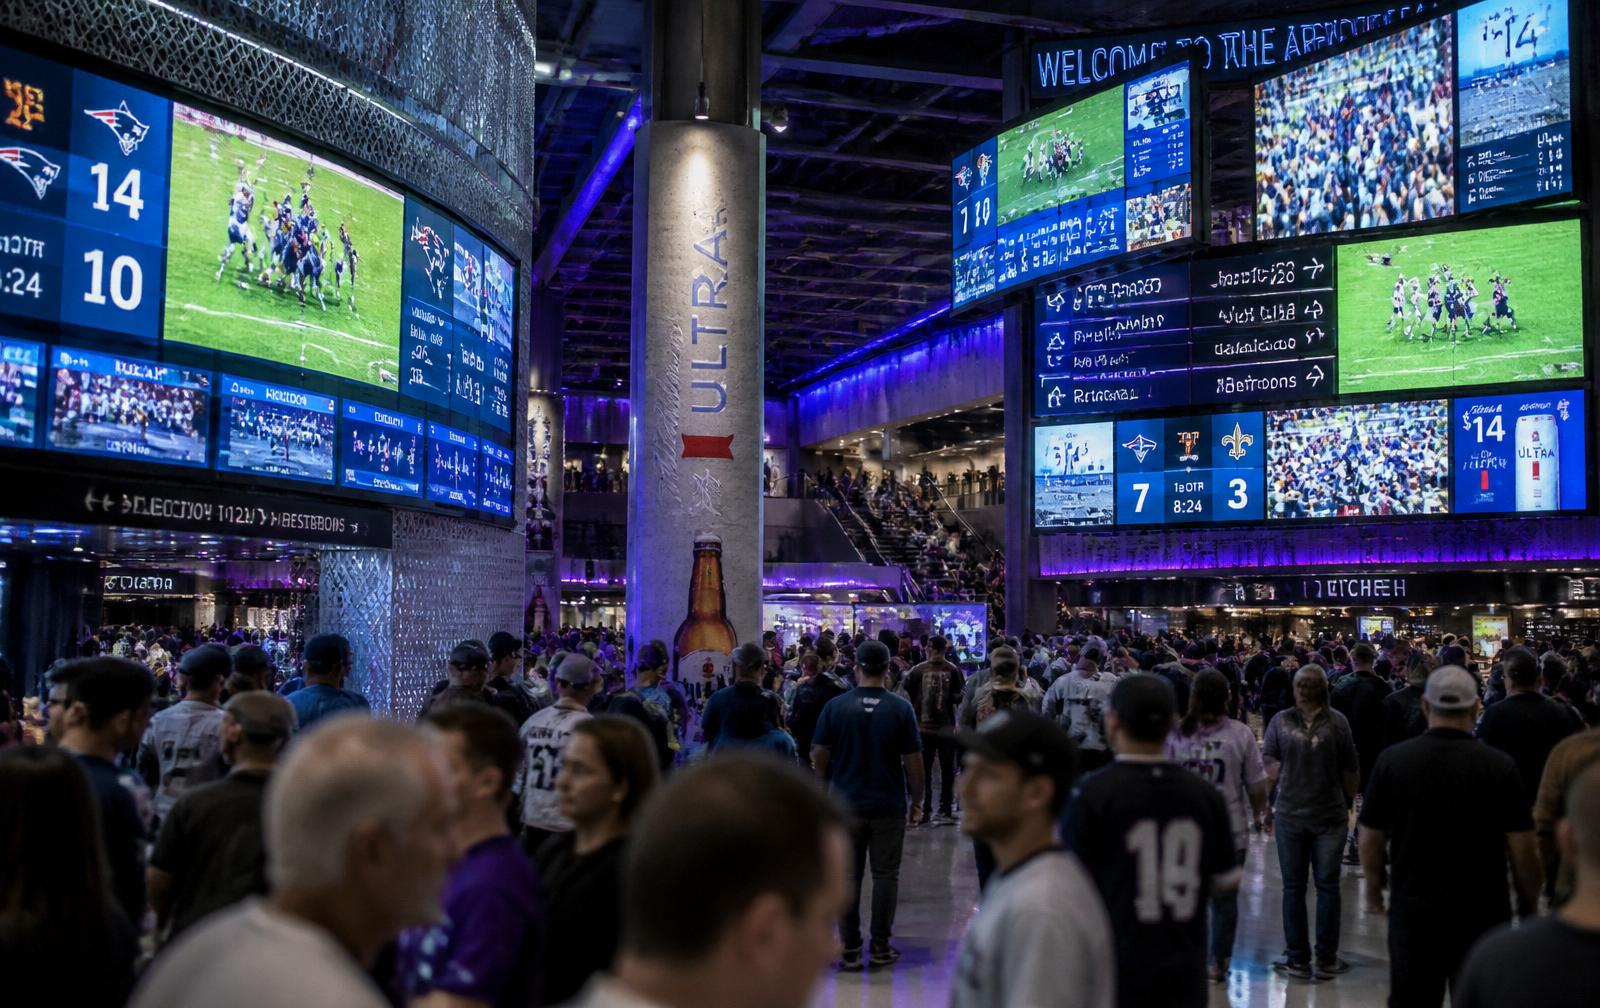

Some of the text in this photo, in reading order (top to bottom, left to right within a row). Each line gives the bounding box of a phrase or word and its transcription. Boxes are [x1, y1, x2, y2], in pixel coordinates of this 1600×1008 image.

[90, 162, 144, 221] 14
[0, 267, 43, 298] :24
[83, 249, 143, 311] 10
[691, 228, 729, 413] ULTRA
[1518, 446, 1555, 459] ULTRA
[1132, 483, 1149, 513] 7
[1173, 499, 1203, 514] 8:24
[1227, 478, 1248, 510] 3
